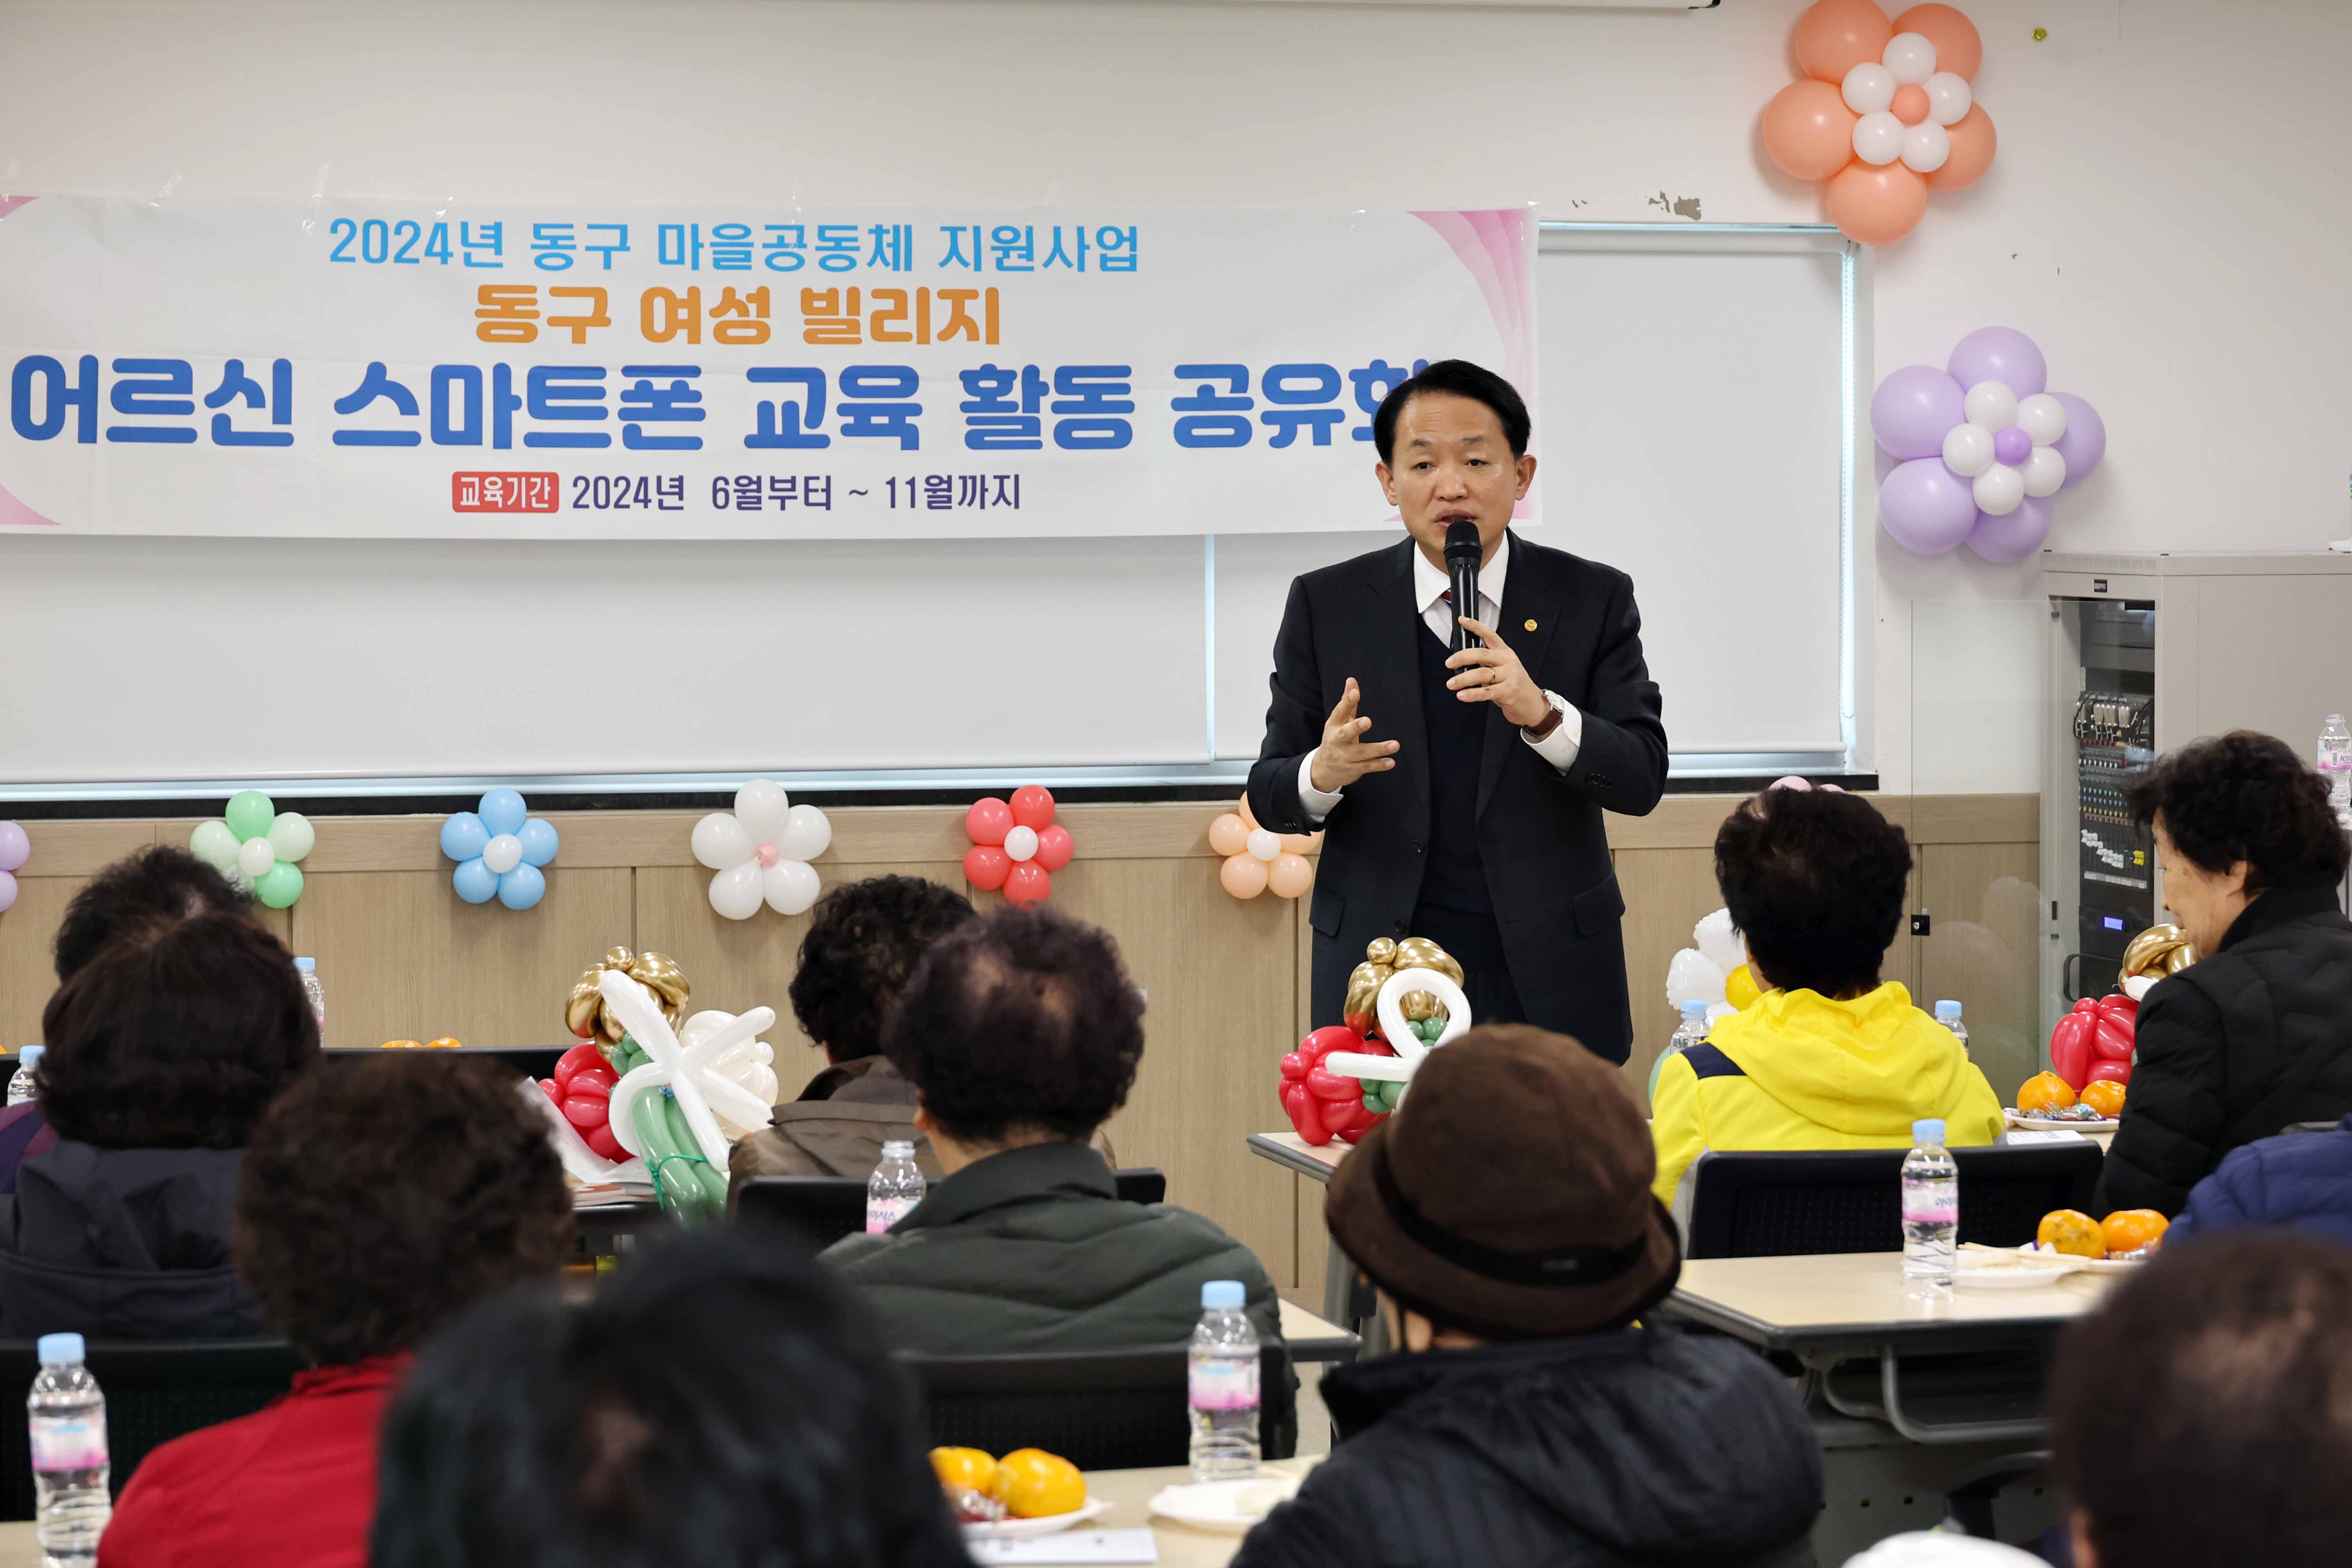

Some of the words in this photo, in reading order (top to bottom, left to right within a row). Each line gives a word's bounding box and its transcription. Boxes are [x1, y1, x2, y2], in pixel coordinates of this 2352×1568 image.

[330, 218, 503, 268] 2024년
[531, 223, 630, 271] 동구
[659, 223, 912, 272] 마을공동체
[939, 226, 1137, 272] 지원사업
[475, 285, 611, 344] 동구
[641, 286, 771, 345] 여성
[801, 287, 999, 345] 빌리지
[12, 355, 294, 446] 어르신
[333, 362, 706, 450] 스마트폰
[744, 366, 922, 450] 교육
[960, 364, 1135, 450] 활동
[460, 476, 552, 509] 교육기간
[573, 476, 684, 510] 2024년
[713, 475, 830, 510] 6월부터
[886, 475, 1019, 509] 11월까지
